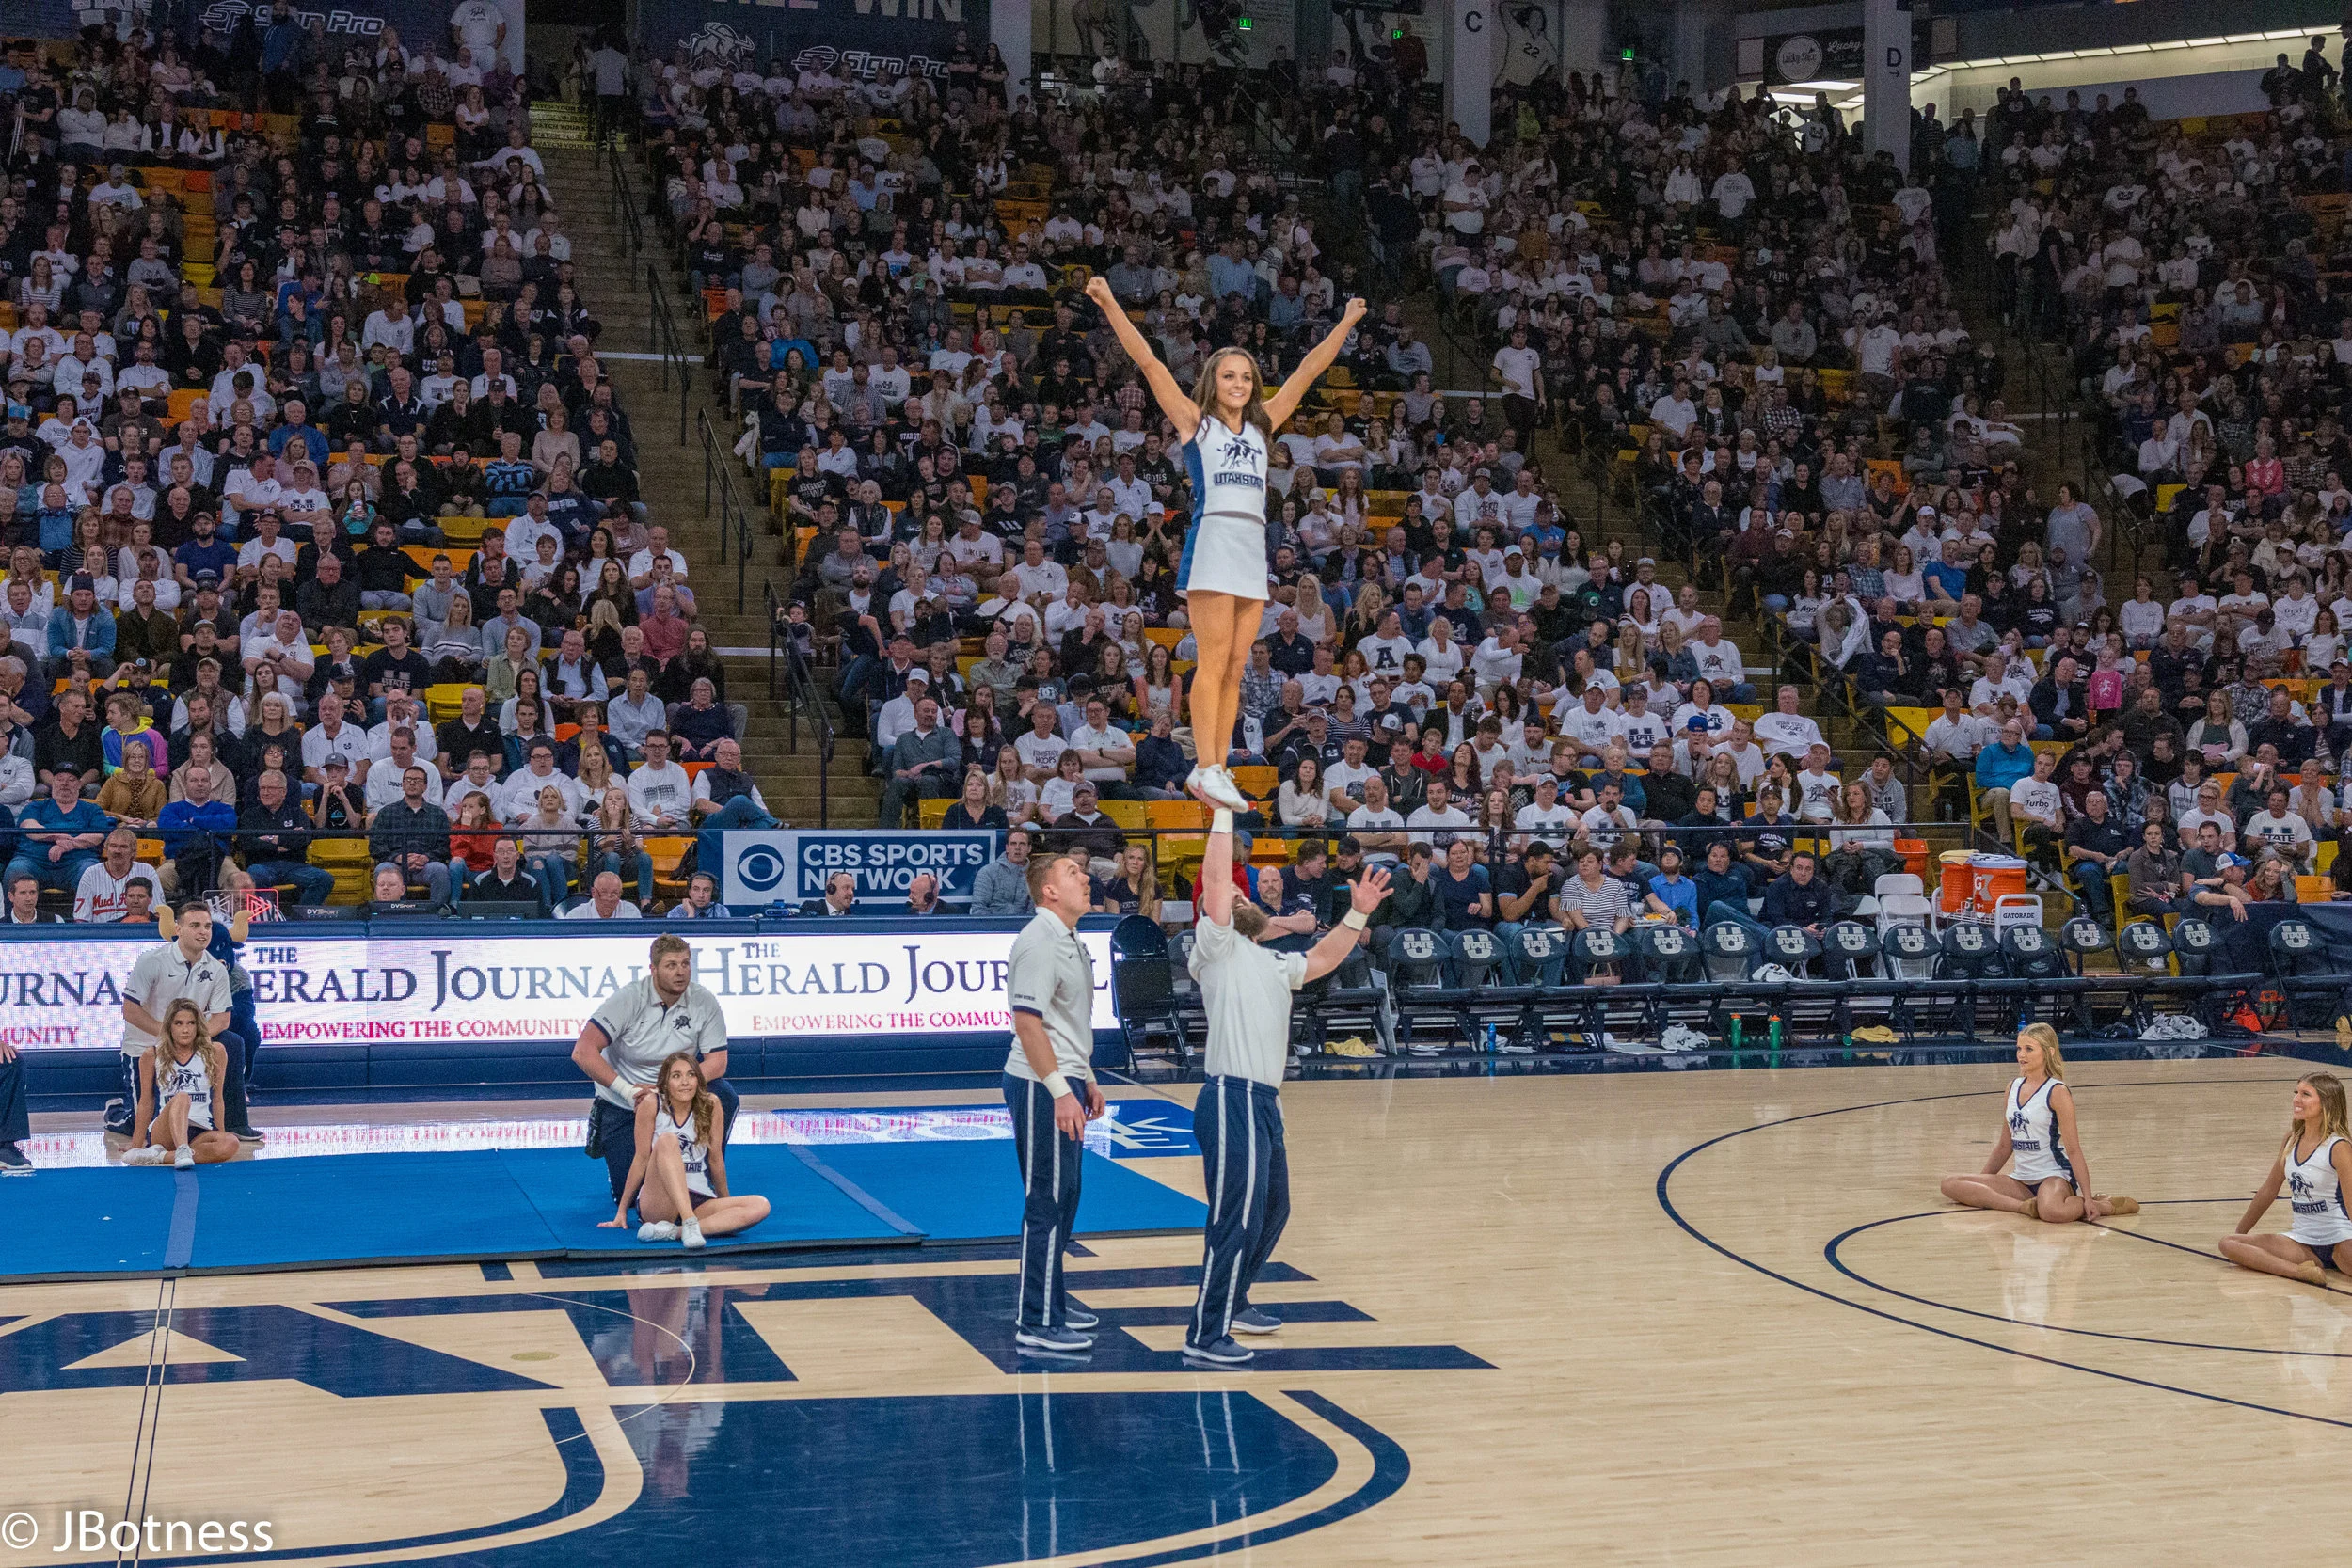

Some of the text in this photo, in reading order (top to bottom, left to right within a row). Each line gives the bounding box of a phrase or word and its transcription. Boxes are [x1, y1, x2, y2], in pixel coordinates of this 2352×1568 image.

[327, 8, 386, 35] Pro
[1464, 10, 1483, 33] C
[1523, 42, 1540, 58] 22
[1886, 48, 1902, 67] D
[842, 51, 904, 78] Sign
[1214, 472, 1264, 492] UTAH STATE
[1375, 647, 1399, 669] A
[378, 678, 411, 691] STATE
[2025, 799, 2050, 808] Turbo
[803, 844, 984, 866] CBS SPORTS
[804, 867, 956, 891] NTWOK
[74, 897, 86, 913] 7
[92, 895, 114, 909] Mud
[254, 946, 298, 964] THE
[741, 942, 781, 958] THE
[252, 968, 418, 1003] ERALD
[902, 945, 1108, 1004] JOURL
[0, 971, 130, 1006] RNA
[262, 1022, 405, 1039] EMPOWERING
[411, 1021, 452, 1037] THE
[456, 1017, 586, 1037] COMMUNITY
[753, 1010, 1012, 1032] EMPOWERING THE COMMU
